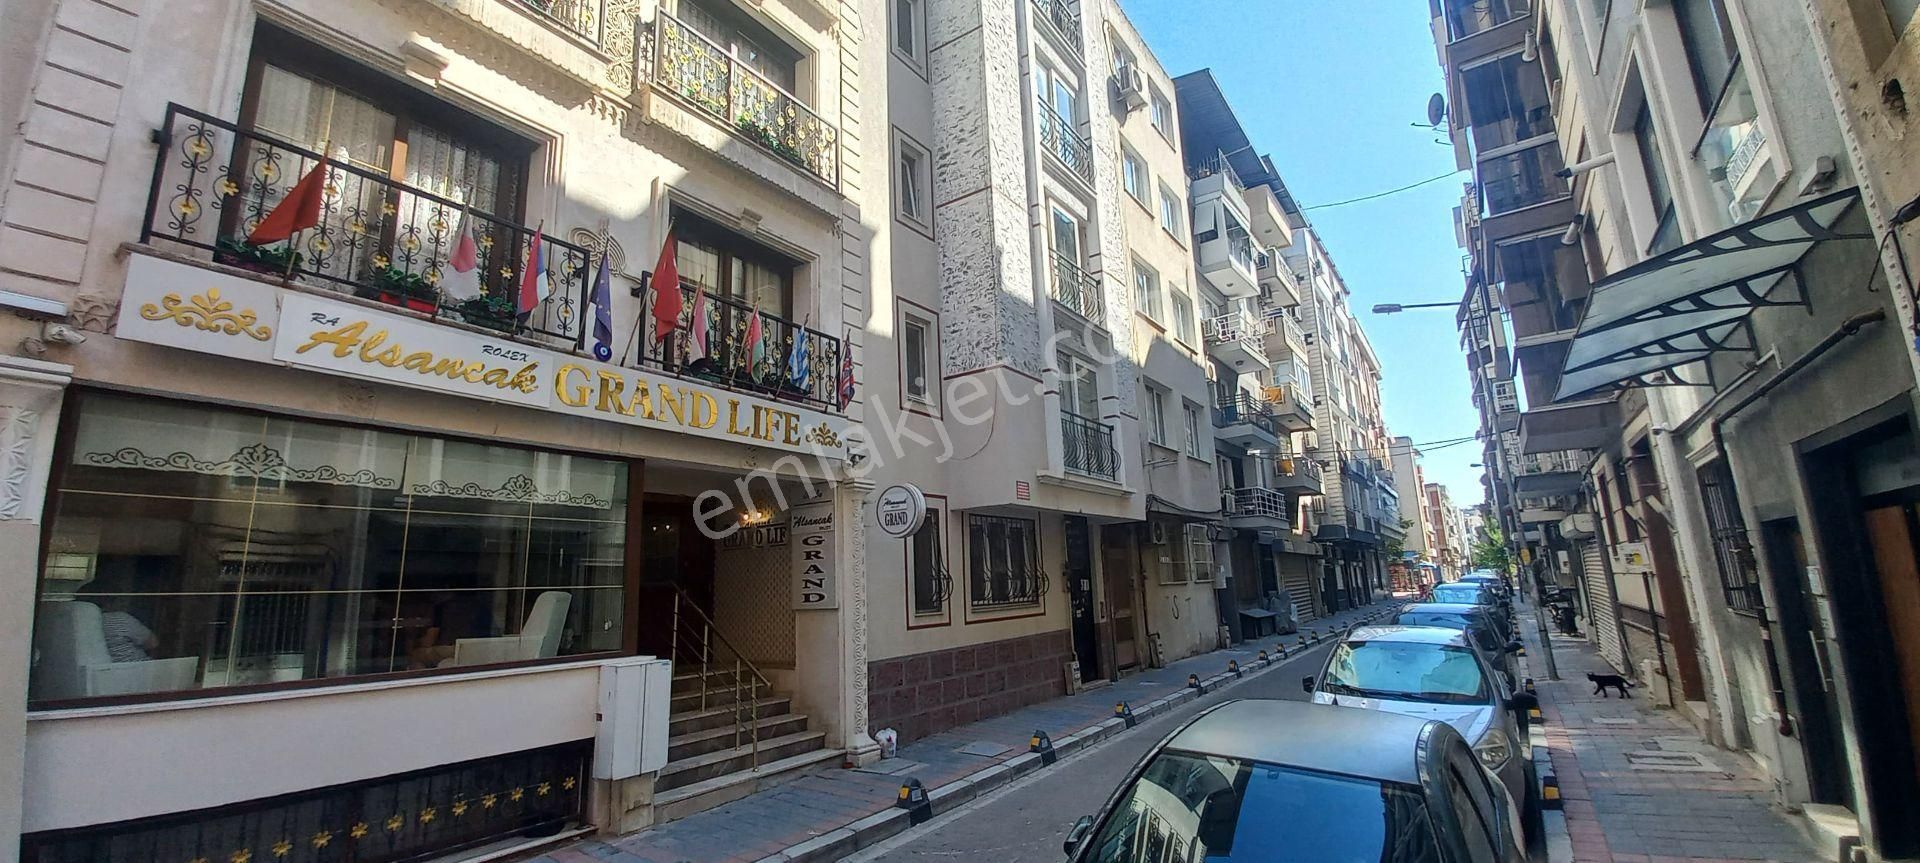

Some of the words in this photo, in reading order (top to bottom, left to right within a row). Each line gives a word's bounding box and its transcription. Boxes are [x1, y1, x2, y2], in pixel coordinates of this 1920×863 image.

[311, 312, 340, 327] RA
[482, 344, 530, 363] ROLEX
[296, 320, 540, 393] Alsancak
[554, 363, 718, 430] GRAND
[725, 399, 801, 447] LIFE
[885, 511, 908, 526] GRAND
[802, 535, 826, 603] GRAND
